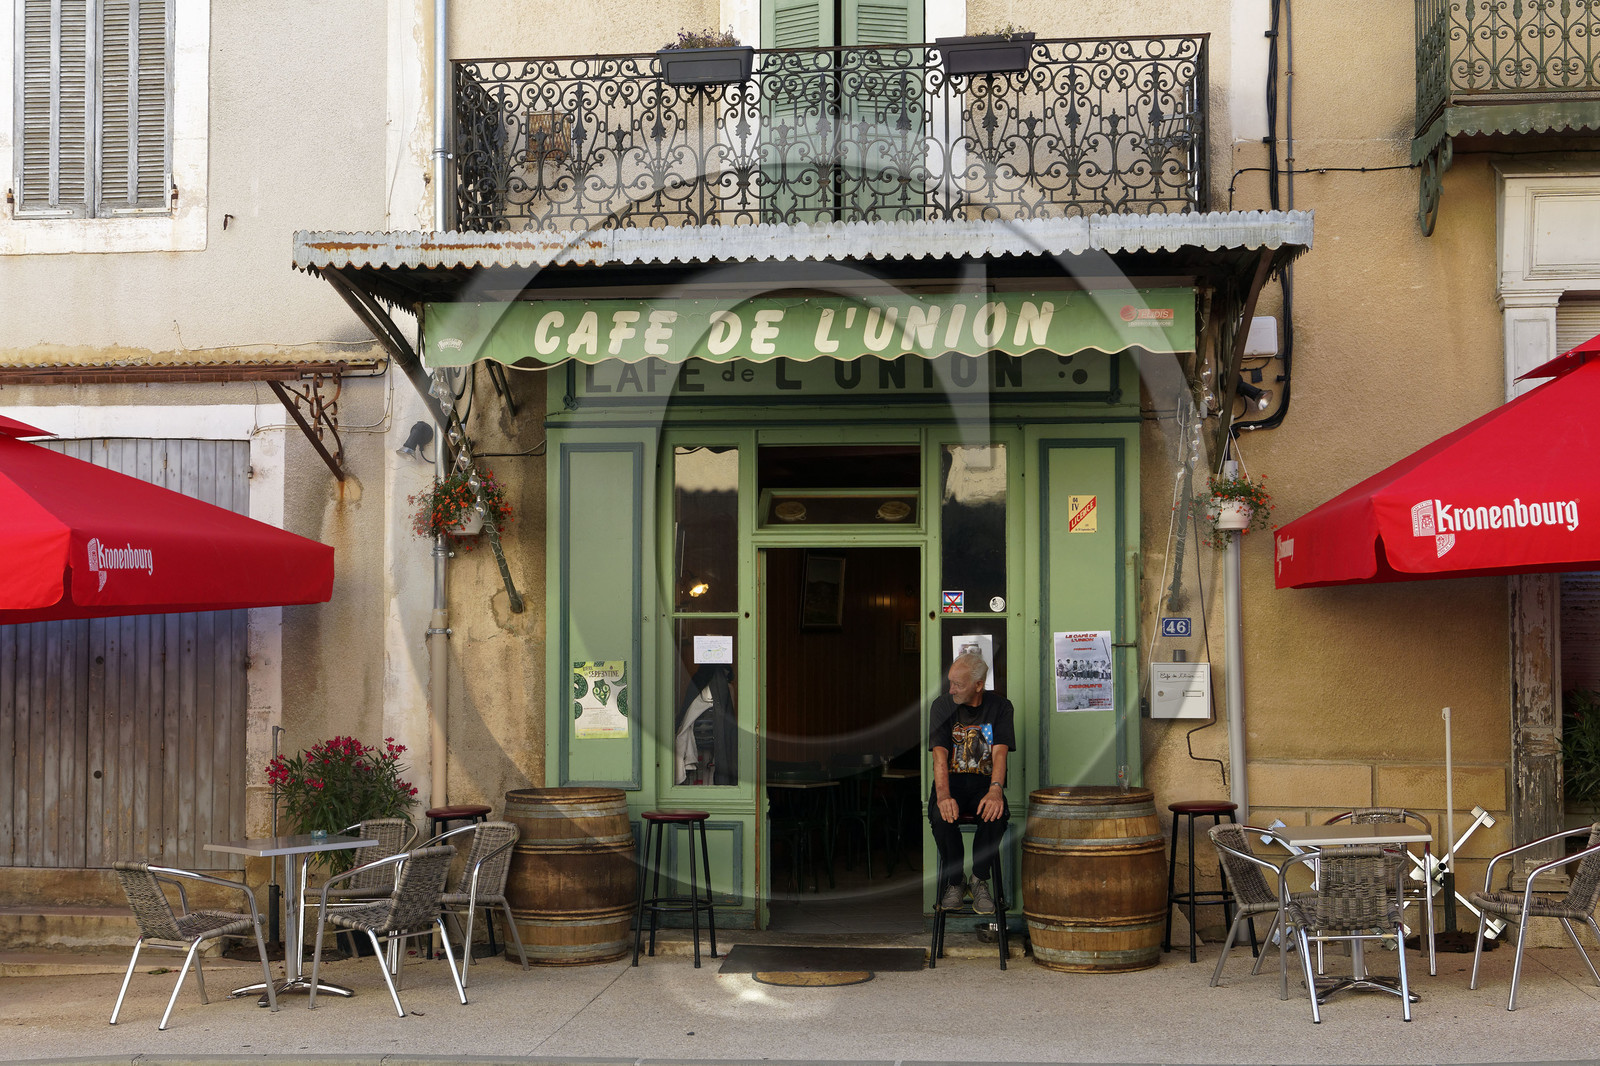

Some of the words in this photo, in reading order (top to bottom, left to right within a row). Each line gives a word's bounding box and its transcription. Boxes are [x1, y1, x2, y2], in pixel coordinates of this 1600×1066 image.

[533, 310, 679, 356] CAFE
[707, 310, 785, 355] DE
[813, 300, 1055, 353] L'UNION
[721, 358, 755, 382] de
[1071, 500, 1095, 528] LICENCE
[1434, 497, 1579, 532] Kronenbourg
[95, 537, 154, 577] Kronenbourg
[1166, 620, 1187, 634] 46
